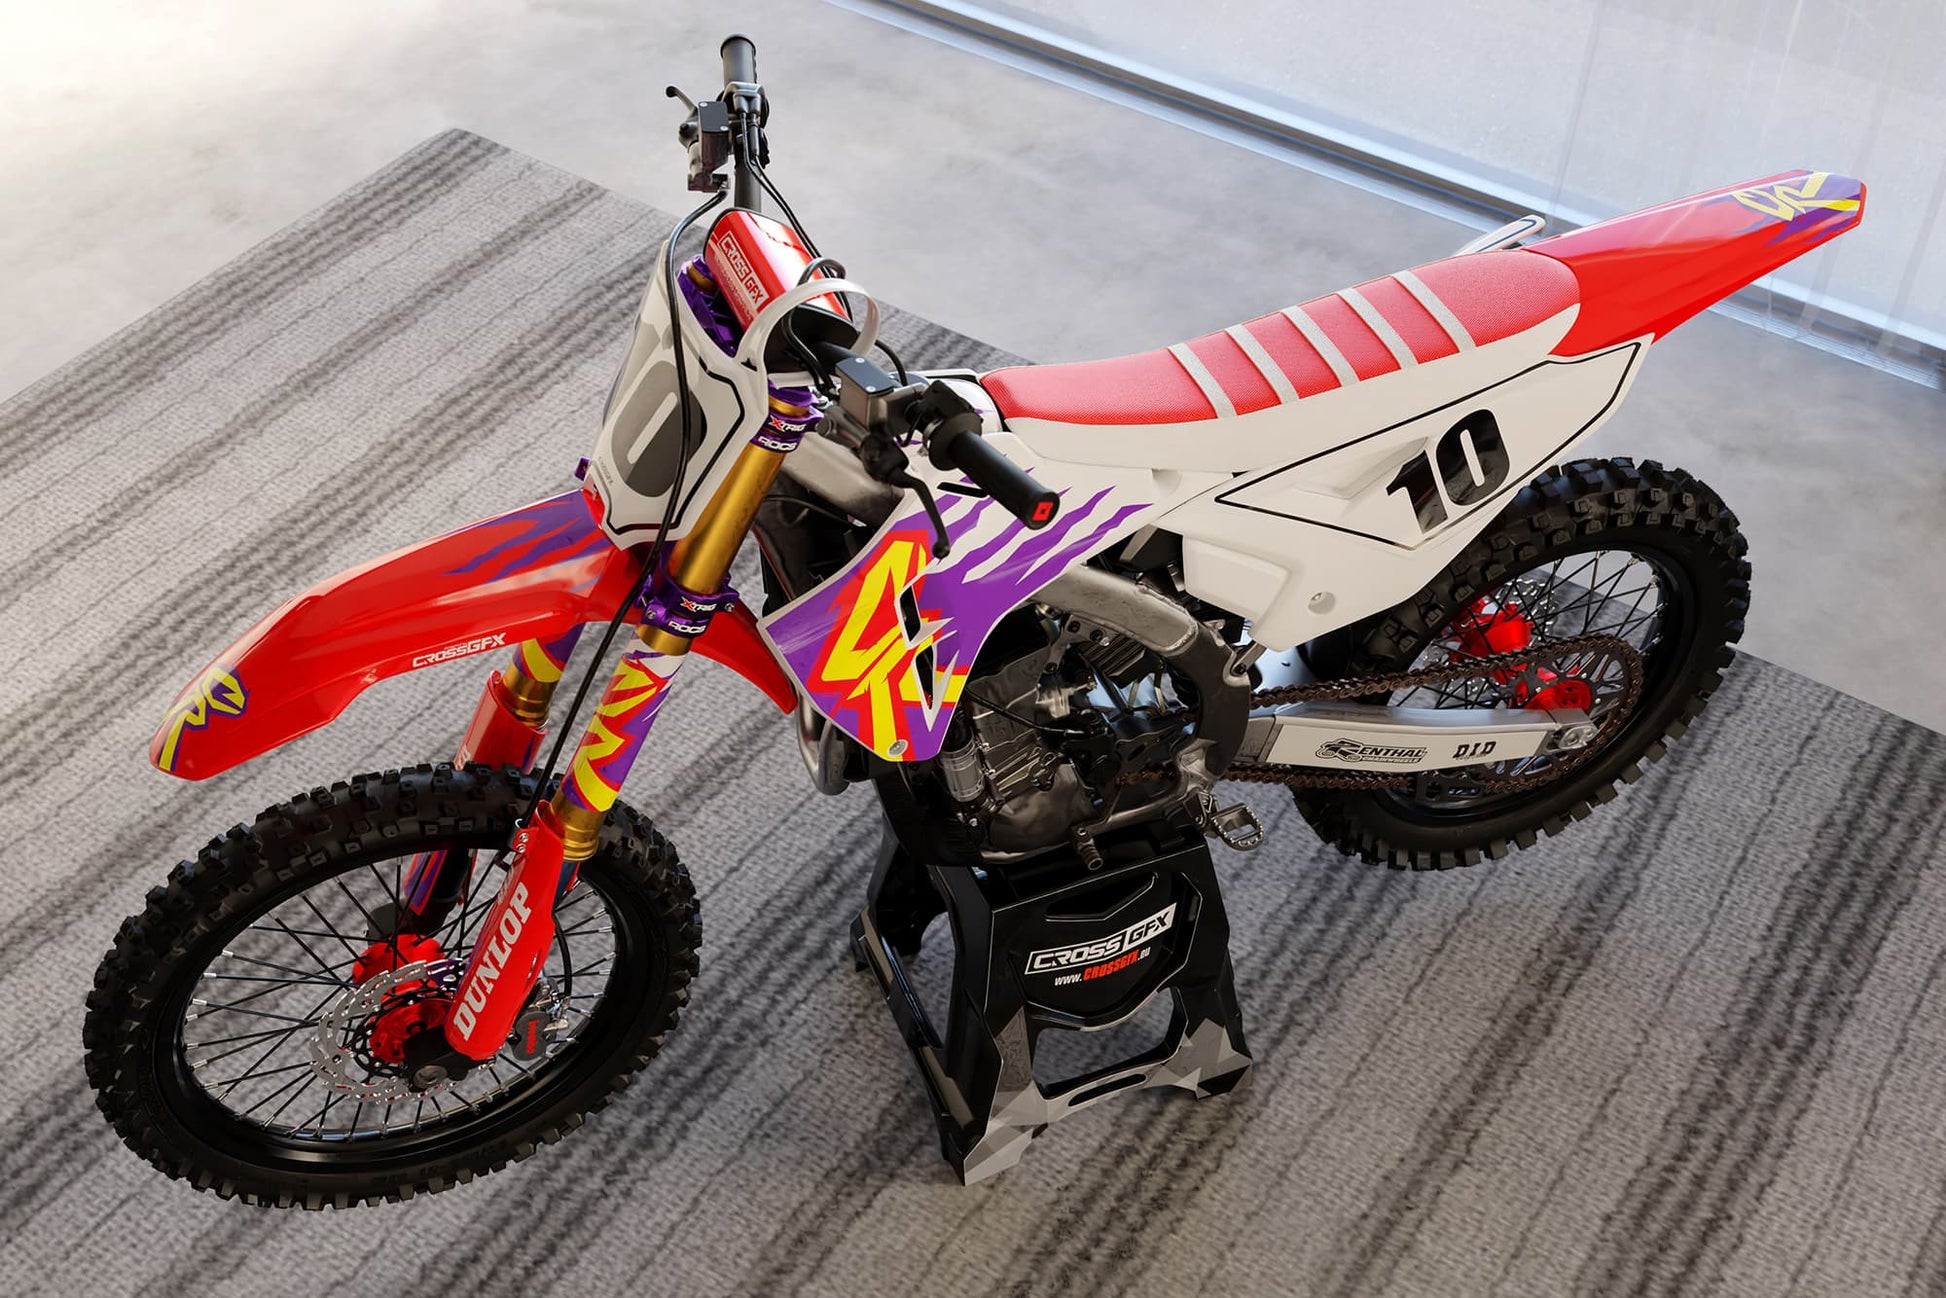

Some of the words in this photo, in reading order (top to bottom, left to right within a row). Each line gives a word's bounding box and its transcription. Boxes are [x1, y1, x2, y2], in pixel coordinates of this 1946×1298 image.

[1386, 408, 1511, 535] 10
[412, 632, 507, 668] CROSSGFX
[453, 881, 532, 1042] DUNLOP
